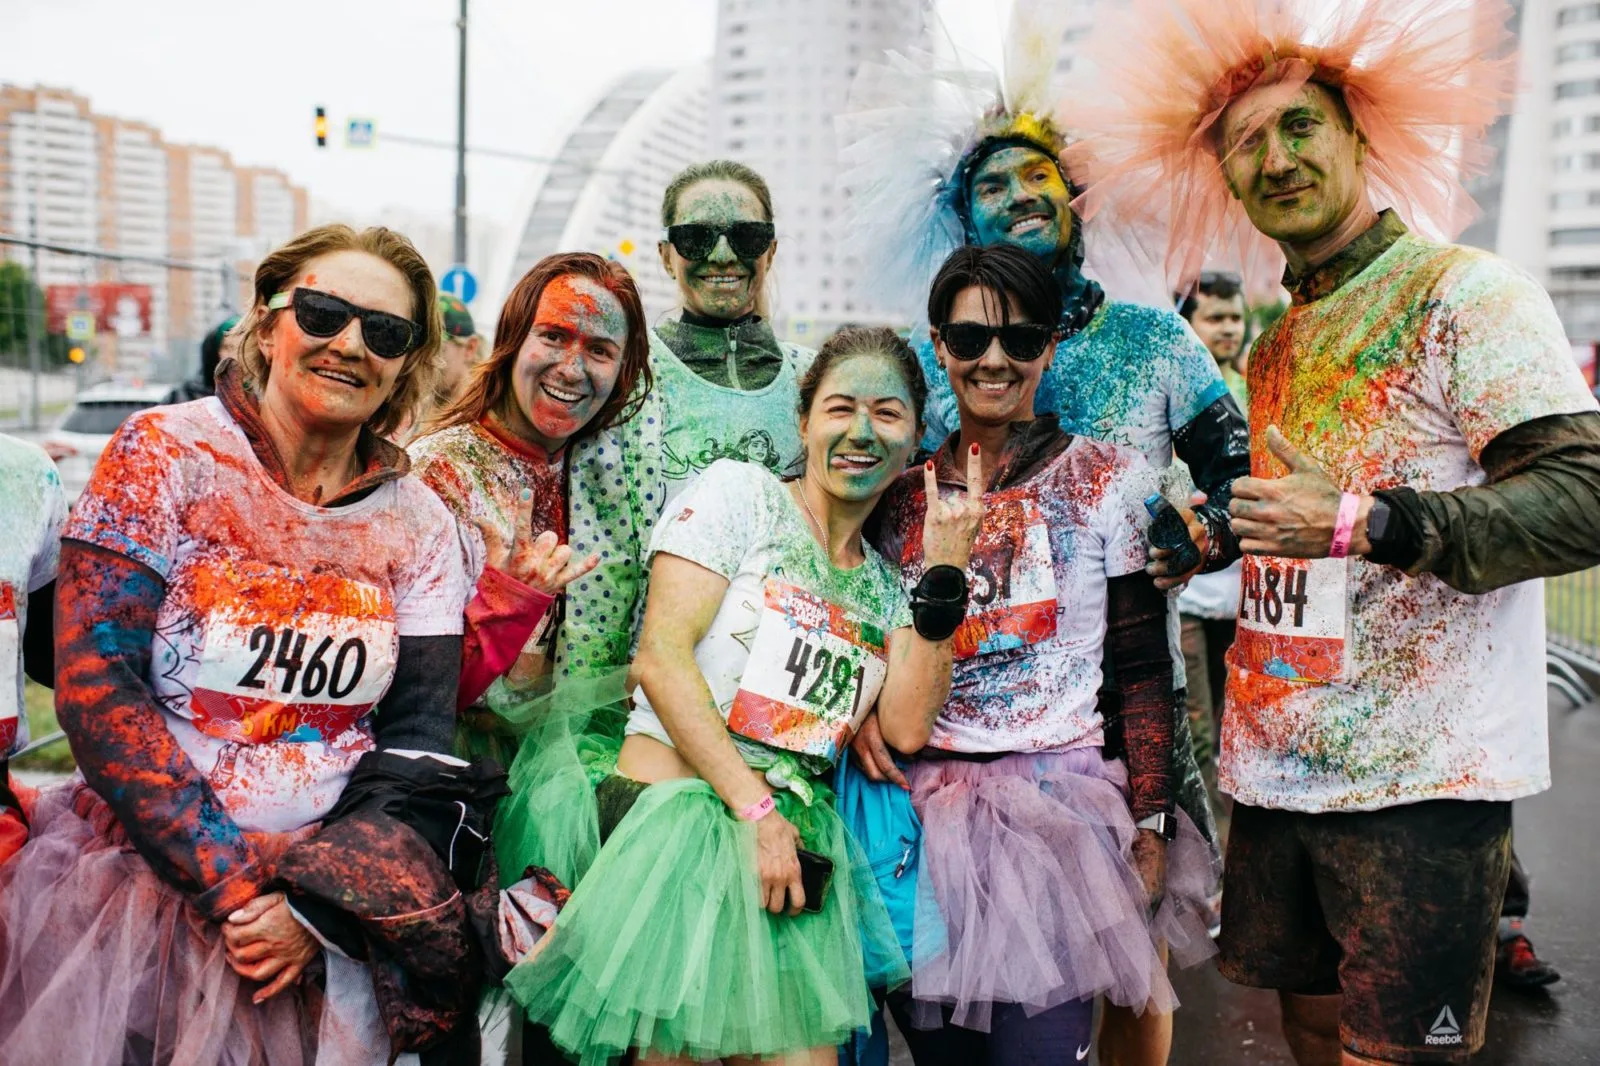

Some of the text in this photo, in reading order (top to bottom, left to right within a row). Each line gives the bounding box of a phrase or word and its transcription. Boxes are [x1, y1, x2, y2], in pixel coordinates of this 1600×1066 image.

[236, 625, 367, 699] 2460
[784, 636, 865, 718] 4291
[261, 711, 298, 737] KM
[1425, 1034, 1463, 1045] Reebok
